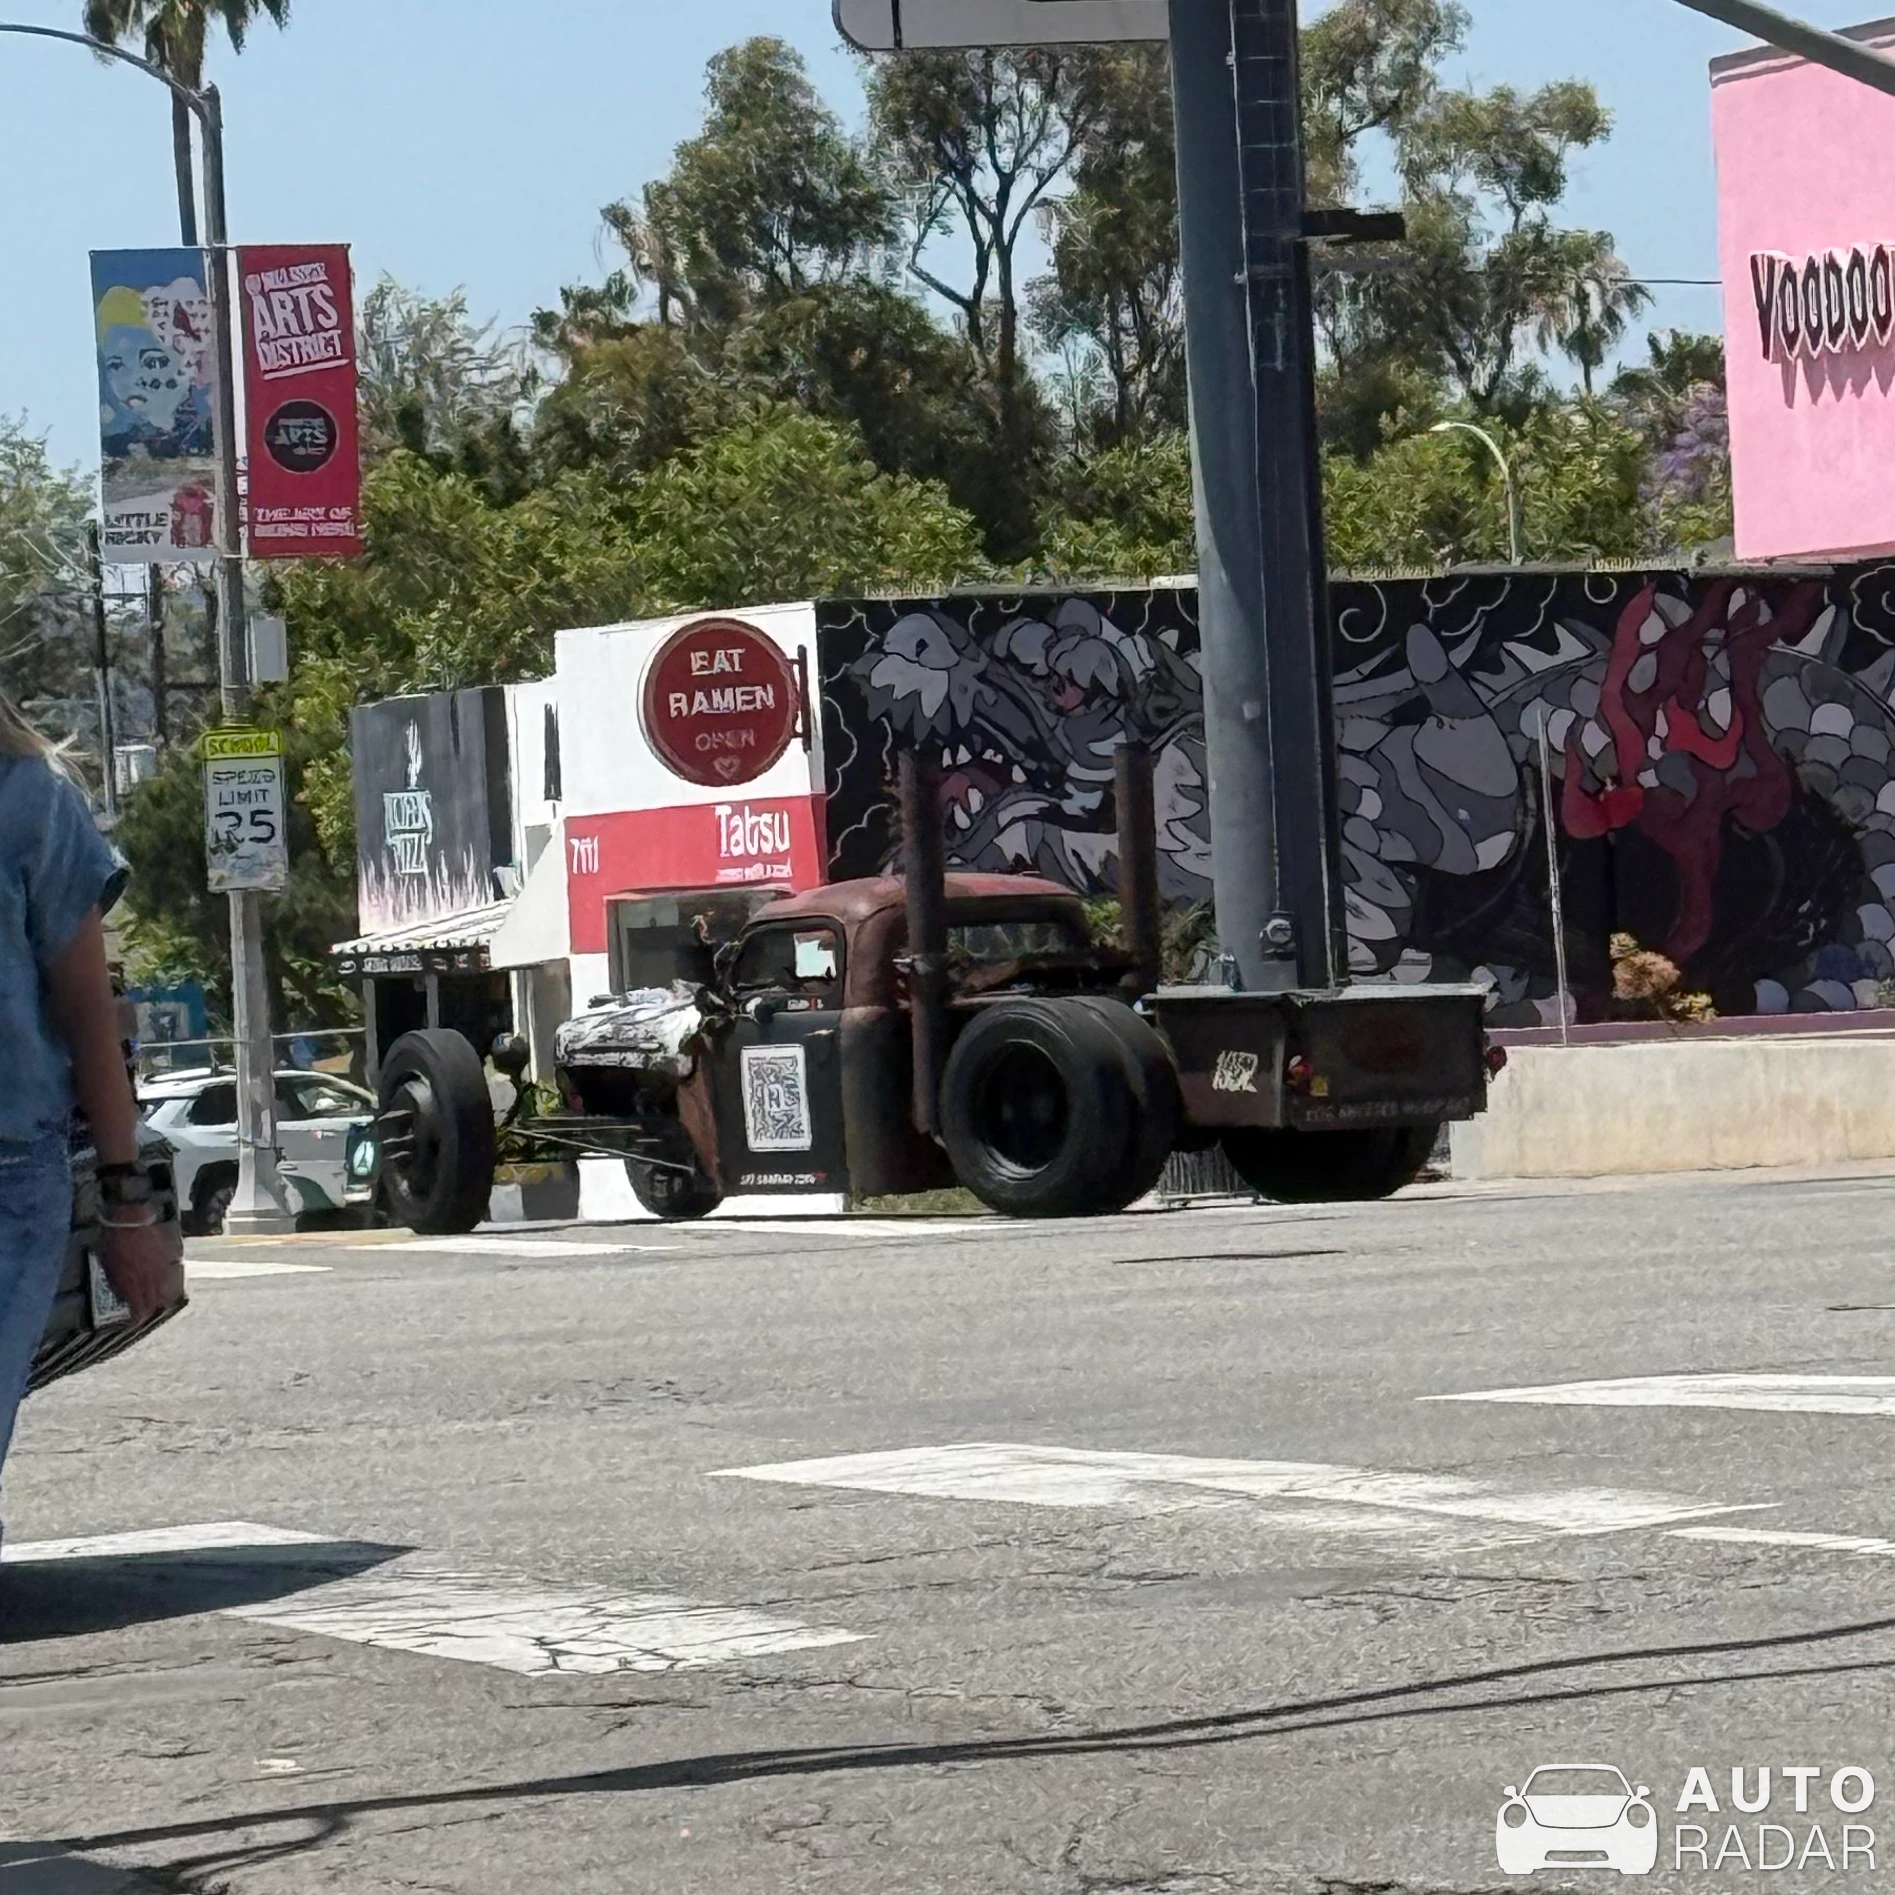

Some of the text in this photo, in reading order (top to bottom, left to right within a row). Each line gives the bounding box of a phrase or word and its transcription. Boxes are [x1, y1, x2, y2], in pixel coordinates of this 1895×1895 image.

[251, 283, 339, 341] ARTS
[1750, 243, 1893, 361] VOODOO
[690, 648, 746, 676] EAT
[668, 683, 776, 718] RAMEN
[219, 789, 269, 806] LIMIT
[715, 805, 791, 858] Tatsu
